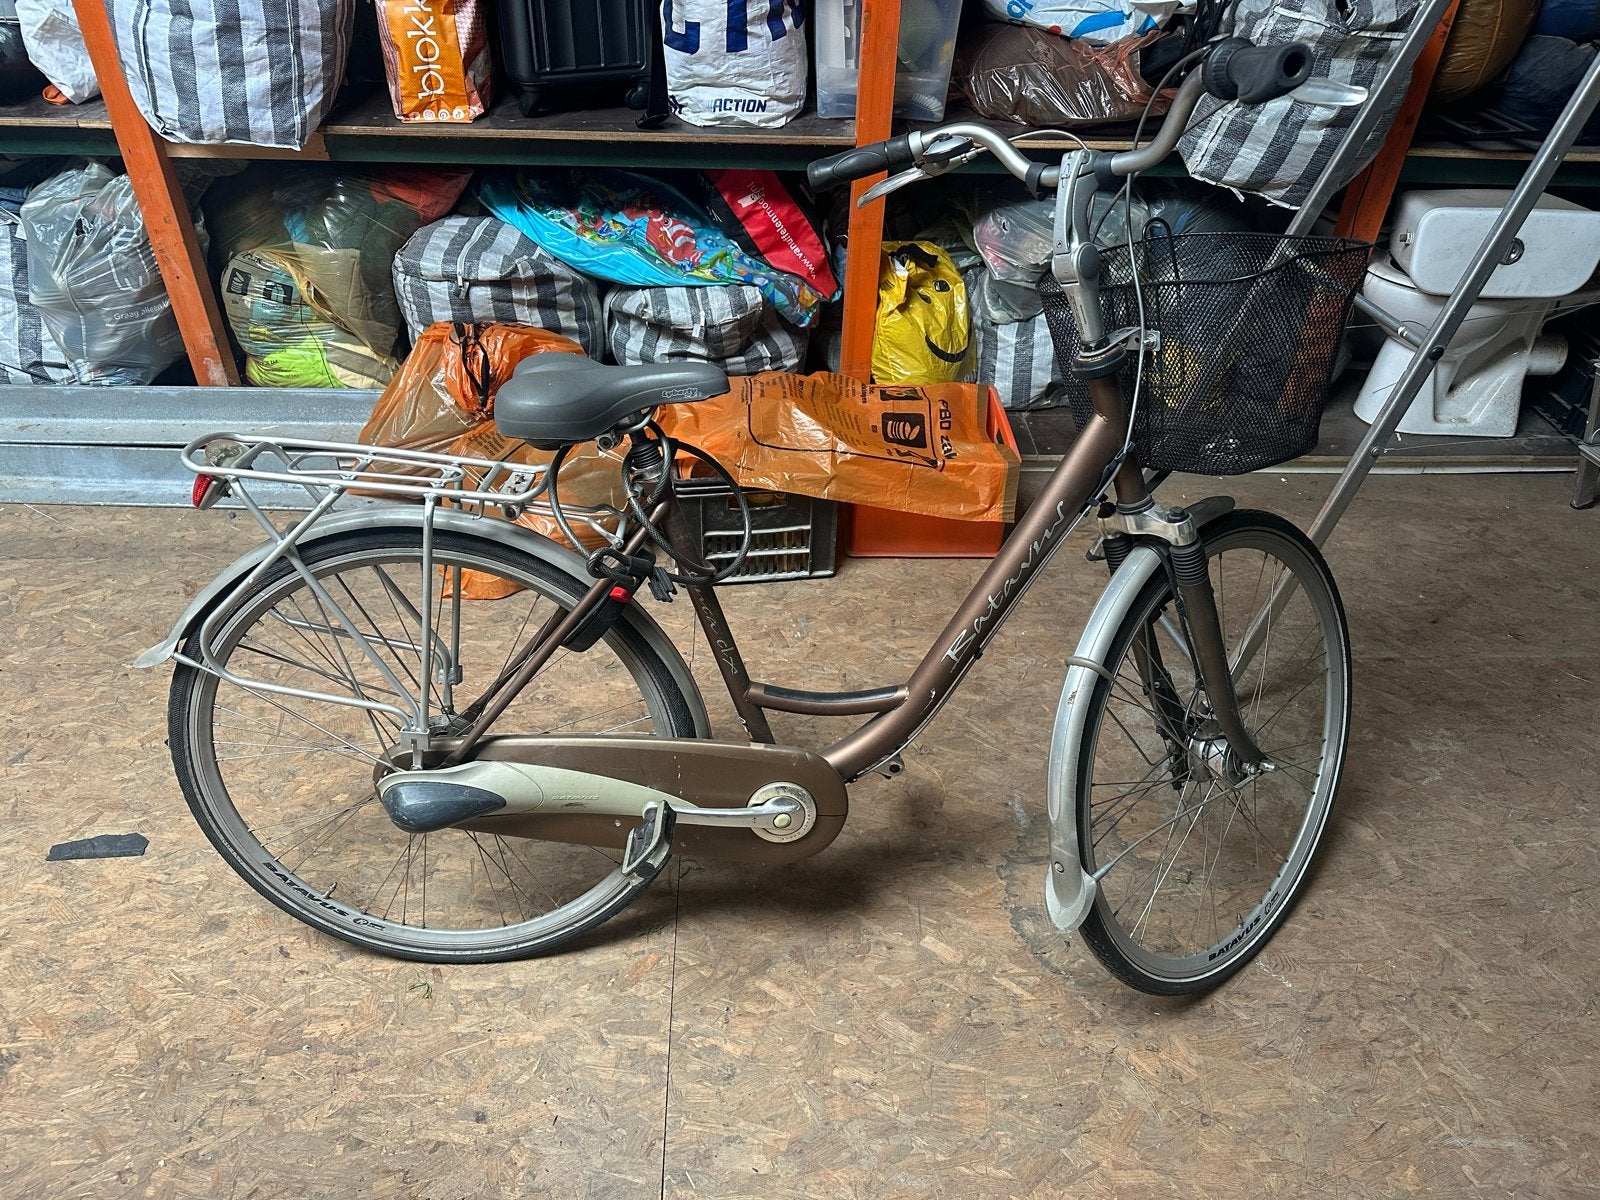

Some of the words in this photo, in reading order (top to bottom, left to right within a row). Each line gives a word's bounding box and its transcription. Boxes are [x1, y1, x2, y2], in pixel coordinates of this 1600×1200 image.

[712, 98, 767, 113] ACTION
[113, 310, 140, 320] Graag
[940, 500, 1065, 674] Batavus
[262, 861, 349, 917] BATAVUS
[1207, 914, 1261, 962] BATAVUS
